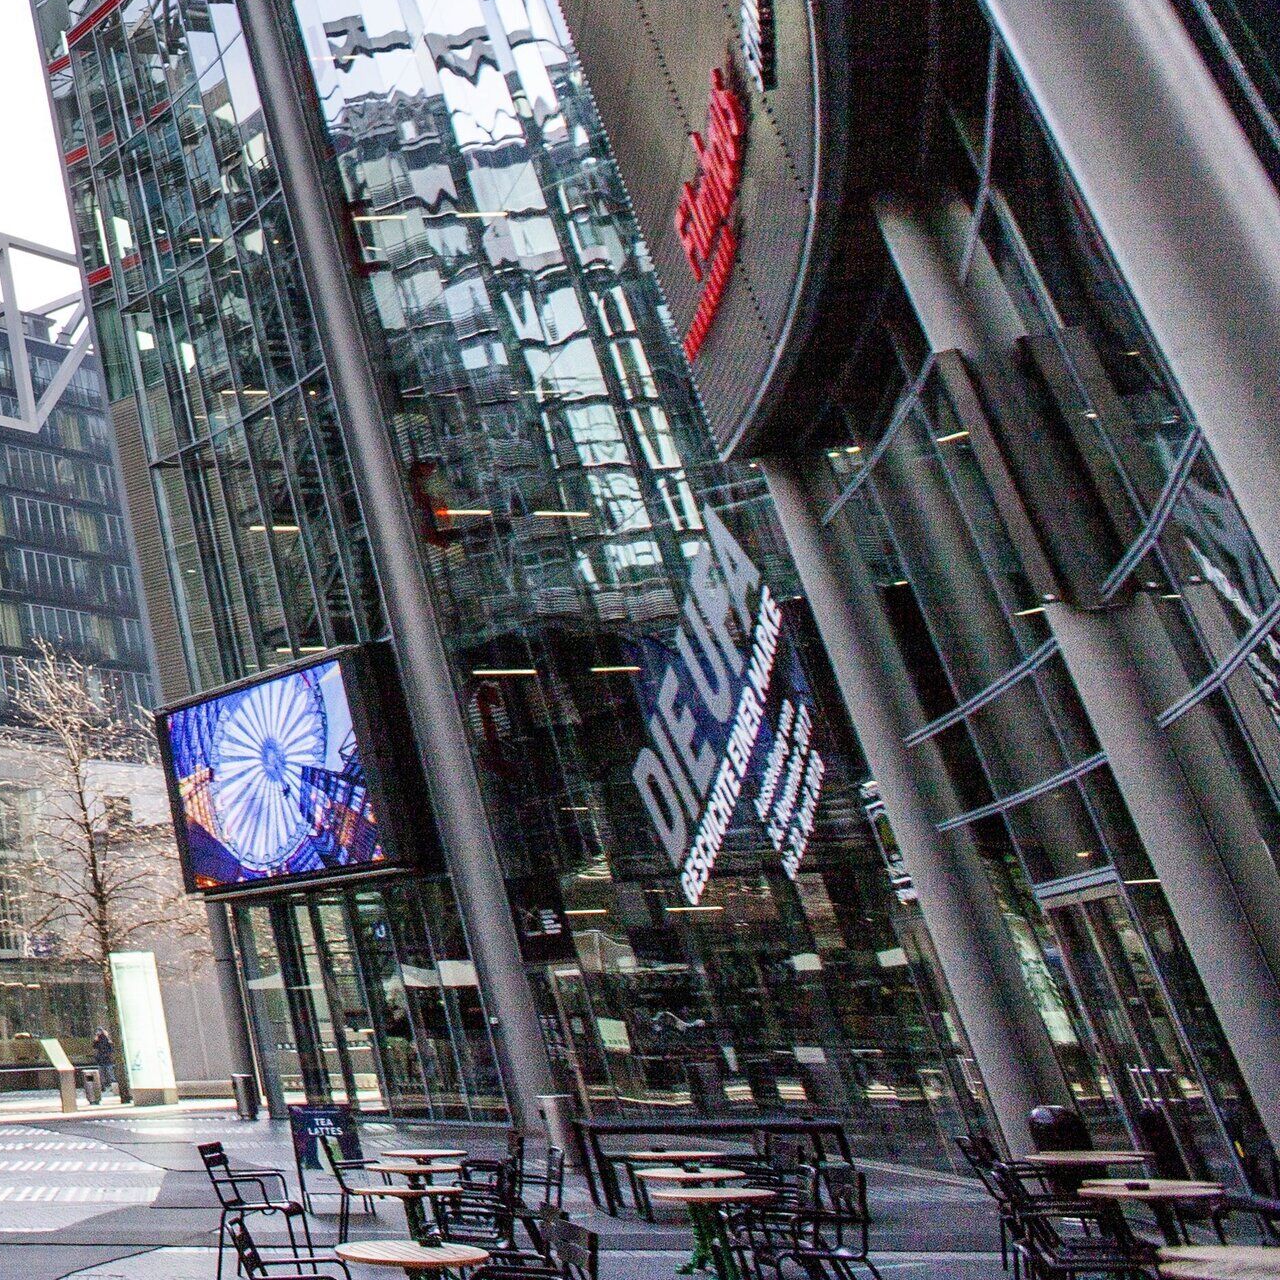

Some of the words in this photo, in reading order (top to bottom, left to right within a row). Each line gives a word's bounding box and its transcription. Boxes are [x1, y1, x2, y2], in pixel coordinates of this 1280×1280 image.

[632, 664, 717, 868] DIE
[676, 503, 761, 724] UFA
[681, 756, 741, 907] GESCHICHTE
[727, 685, 765, 778] EINER
[748, 584, 783, 702] MARKE
[308, 1127, 343, 1135] LATTES
[314, 1118, 334, 1126] TEA
